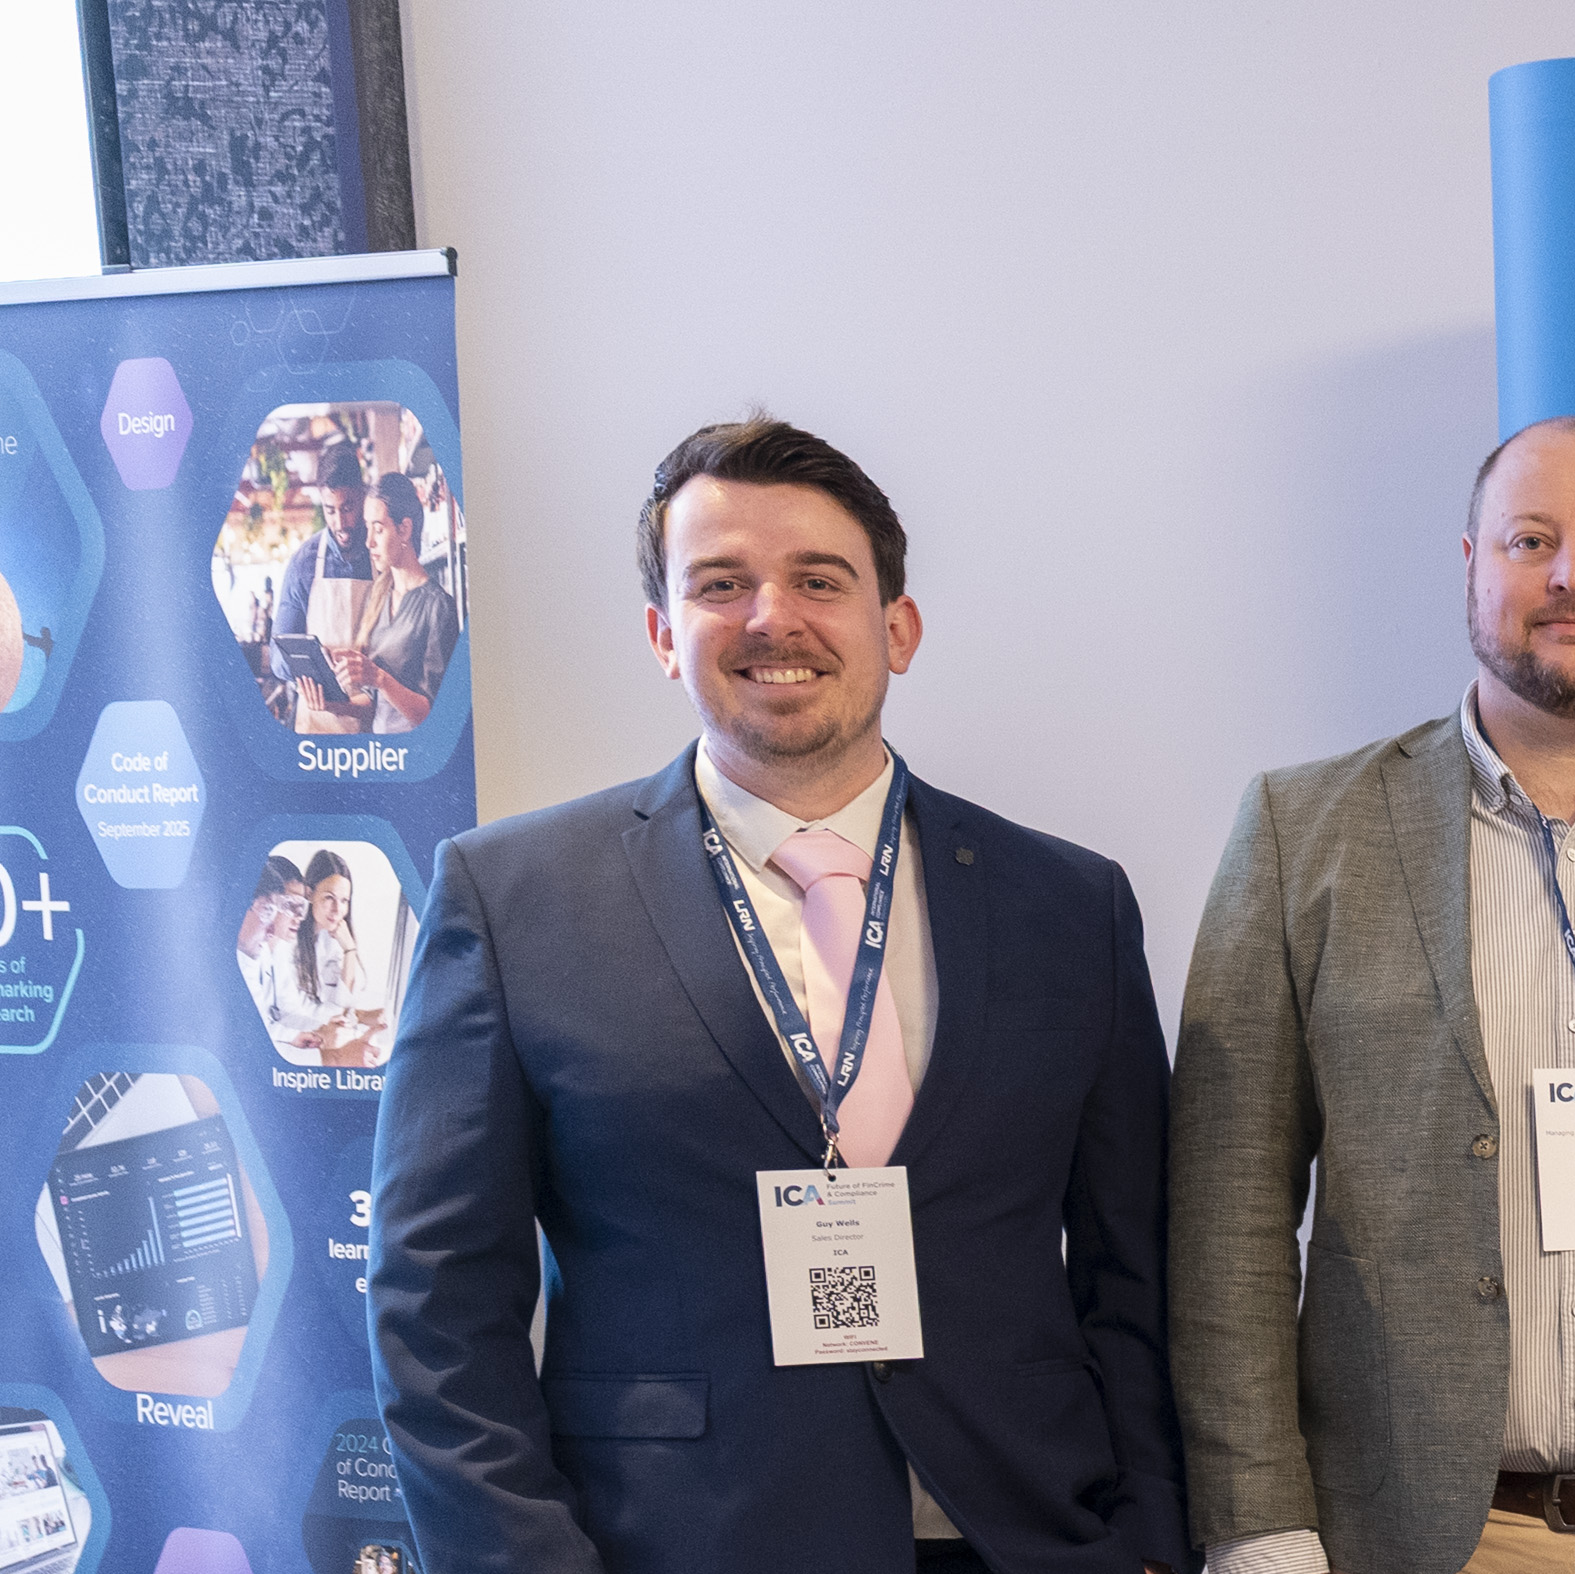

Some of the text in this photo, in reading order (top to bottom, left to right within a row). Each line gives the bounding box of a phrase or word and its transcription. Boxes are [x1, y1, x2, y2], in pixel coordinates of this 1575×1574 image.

[117, 411, 175, 438] Design
[111, 750, 169, 772] Code of
[298, 740, 408, 779] Supplier
[83, 783, 200, 807] Conduct Report
[97, 820, 191, 841] September 2025
[703, 827, 723, 857] ICA
[880, 843, 894, 876] LRN
[732, 898, 756, 932] LRN
[865, 919, 886, 949] ICA
[10, 956, 26, 974] of
[790, 1032, 817, 1063] ICA
[272, 1067, 332, 1093] Inspire
[837, 1052, 856, 1087] LRN
[774, 1184, 826, 1207] ICA
[834, 1190, 878, 1198] Compliance
[816, 1219, 860, 1228] Guy Wells
[834, 1233, 864, 1241] Director
[135, 1393, 214, 1431] Reveal
[335, 1433, 379, 1454] 2024
[336, 1458, 352, 1475] of
[338, 1479, 392, 1504] Report
